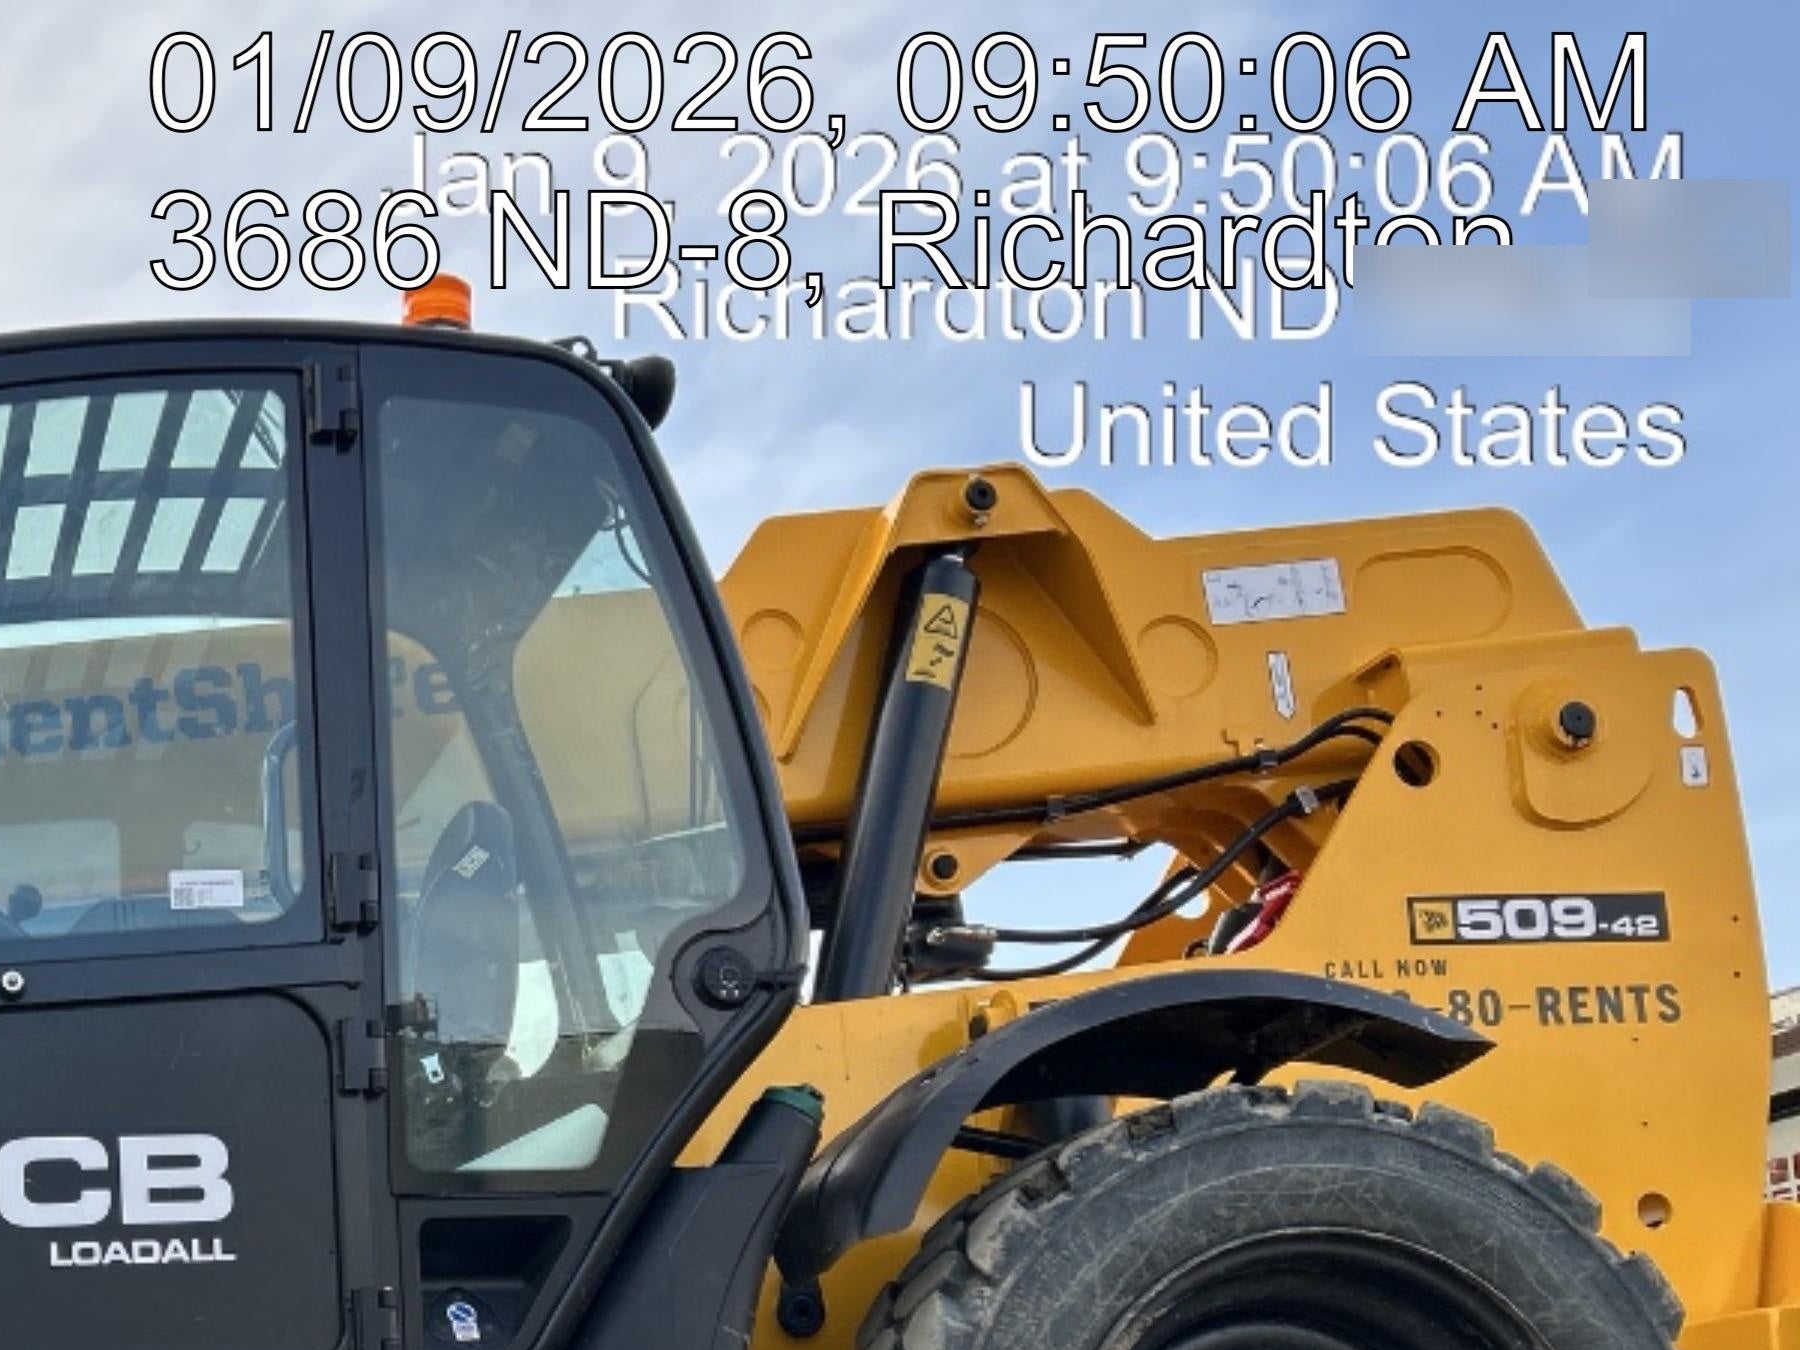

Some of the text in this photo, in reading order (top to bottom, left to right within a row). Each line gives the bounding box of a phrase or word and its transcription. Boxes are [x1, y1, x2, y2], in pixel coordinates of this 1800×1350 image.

[1456, 897, 1661, 941] 509-42
[1325, 959, 1448, 980] CALL NOW
[50, 1238, 238, 1267] LOADALL
